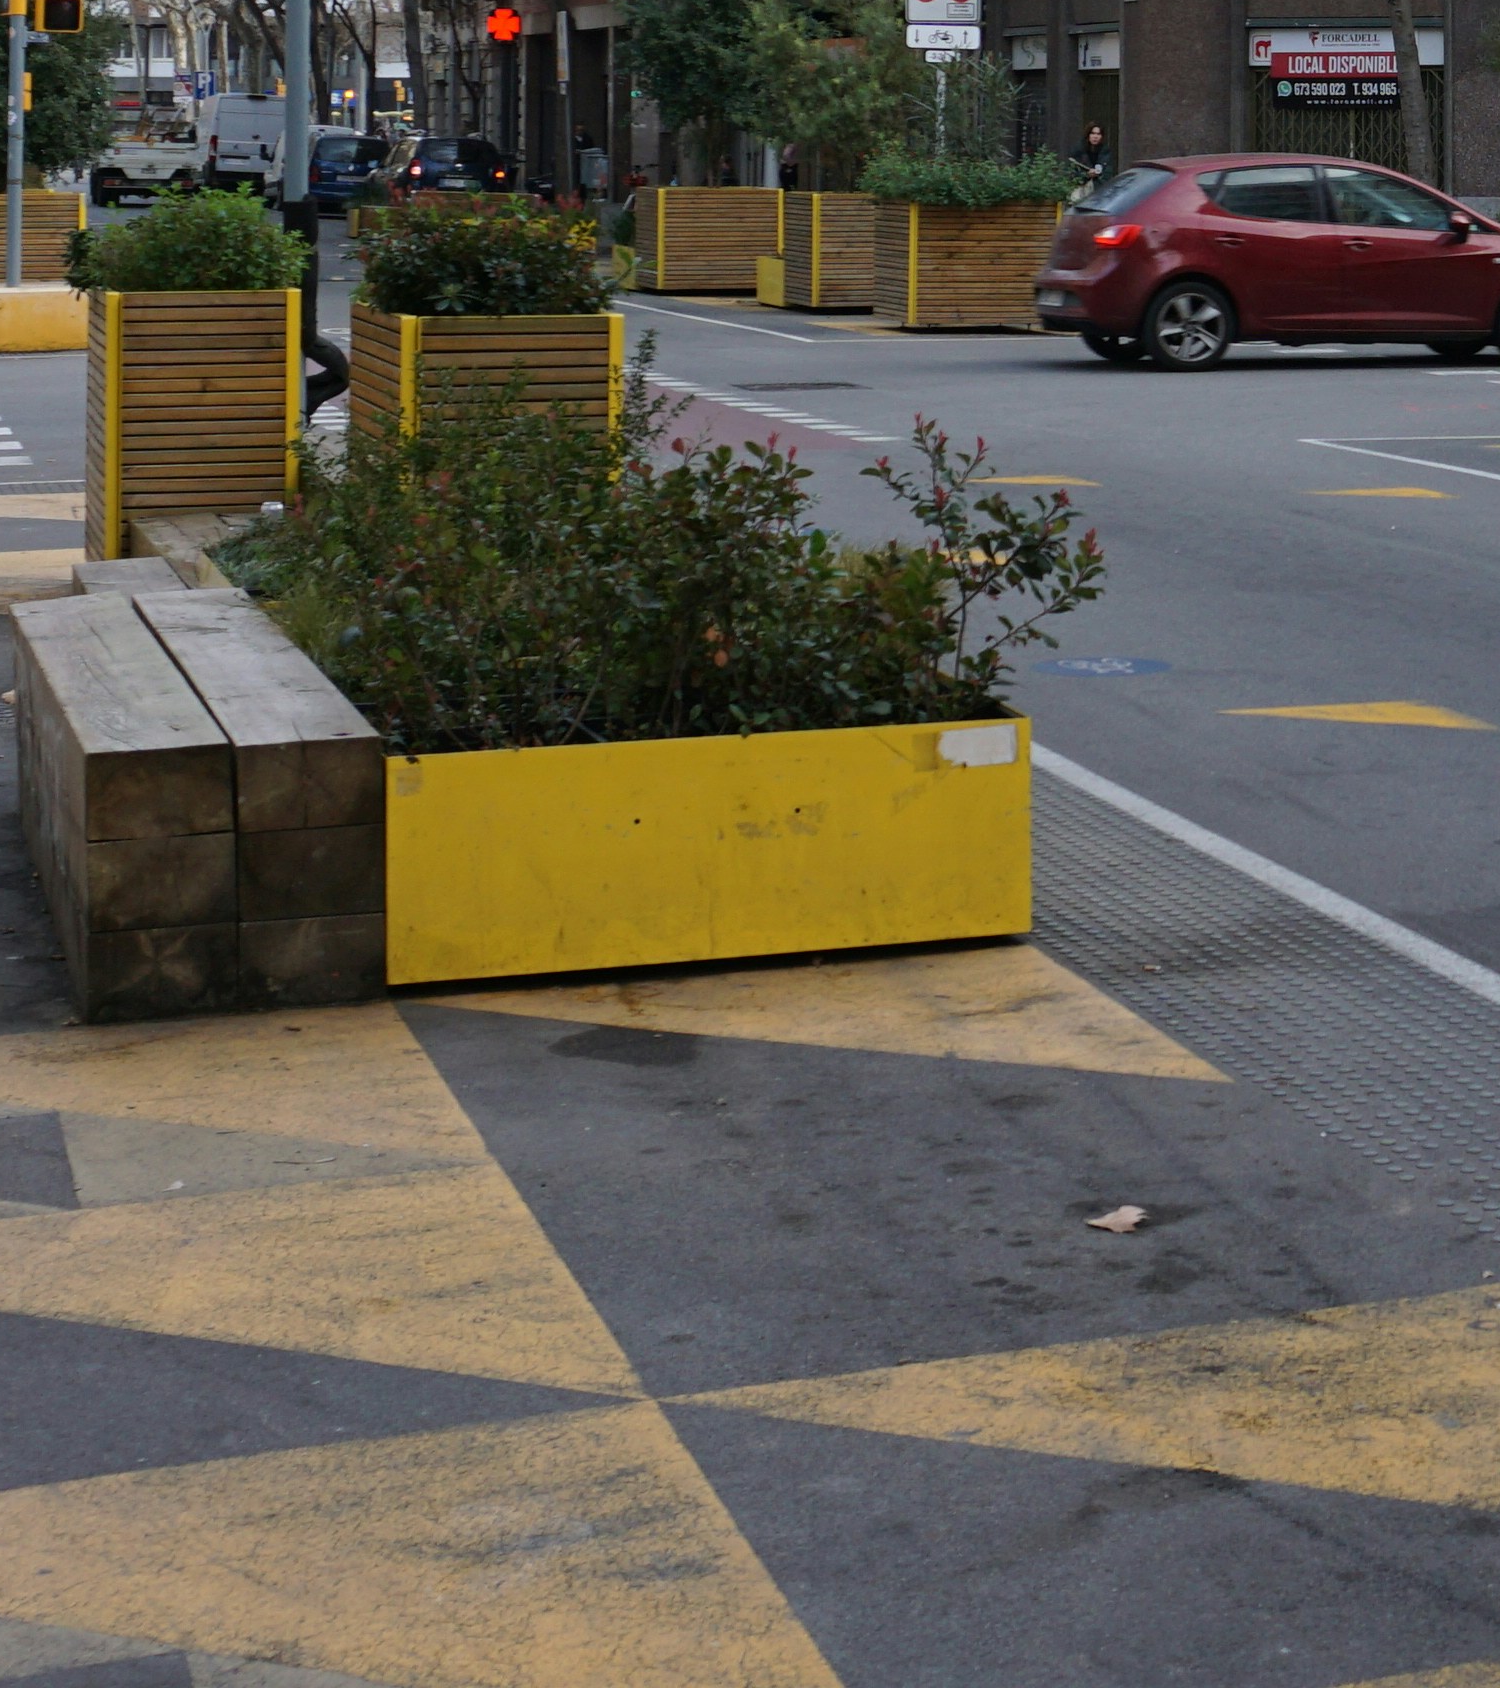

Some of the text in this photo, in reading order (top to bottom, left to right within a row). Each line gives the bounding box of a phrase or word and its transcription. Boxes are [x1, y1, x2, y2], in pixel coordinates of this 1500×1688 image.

[1321, 33, 1380, 43] FORCADELL
[1288, 56, 1326, 74] LOCAL
[1311, 83, 1328, 96] 590
[1329, 83, 1346, 96] 023
[1361, 83, 1379, 95] 934
